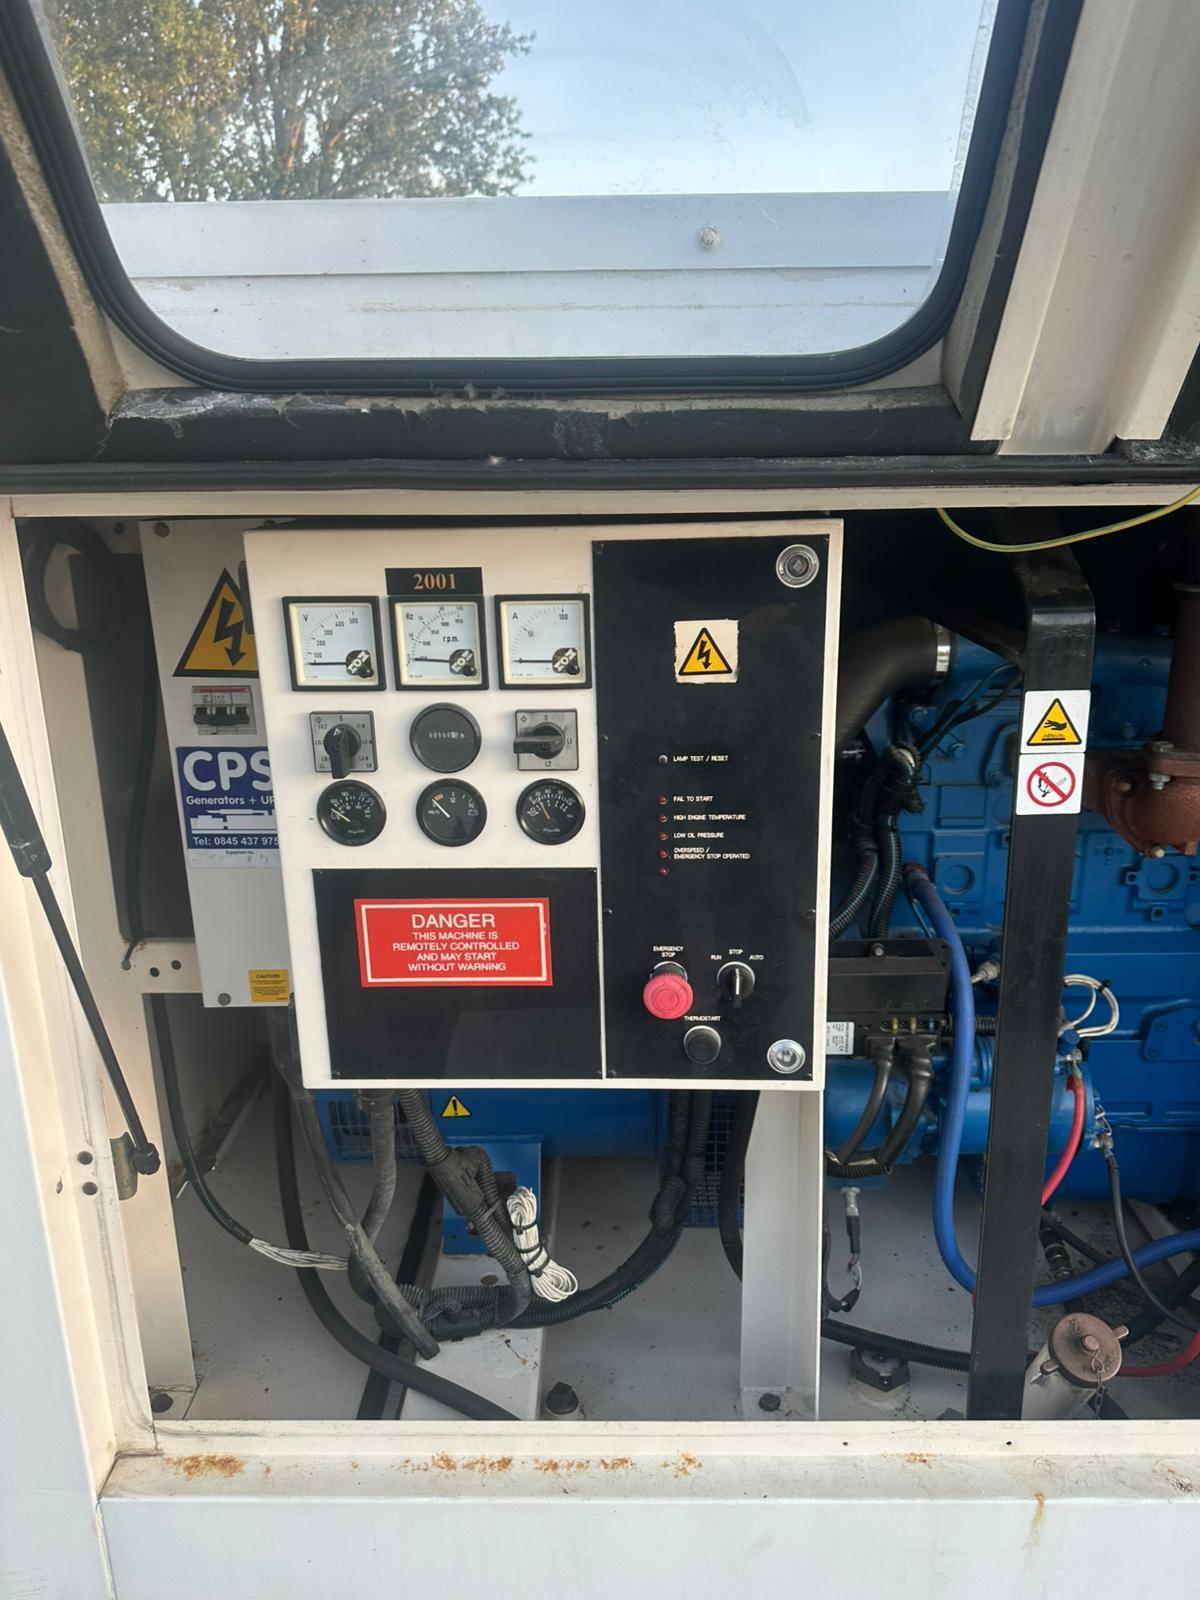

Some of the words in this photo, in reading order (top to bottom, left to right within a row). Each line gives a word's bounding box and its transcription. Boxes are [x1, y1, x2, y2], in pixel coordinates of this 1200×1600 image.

[412, 573, 457, 590] 2001
[302, 614, 309, 622] V
[512, 612, 519, 620] A
[559, 613, 569, 621] 100
[183, 751, 274, 791] CPS
[186, 795, 245, 805] Generators
[193, 836, 211, 846] Tel:
[214, 836, 238, 846] 0845
[240, 836, 259, 846] 437
[411, 914, 496, 928] DANGER
[413, 932, 437, 941] THIS
[438, 932, 485, 940] MACHINE
[488, 931, 499, 940] IS
[393, 942, 448, 952] REMOTELY
[449, 942, 520, 951] CONTROLLED
[416, 952, 439, 961] AND
[440, 952, 462, 961] MAY
[464, 952, 497, 961] START
[408, 963, 455, 972] WITHOUT
[457, 962, 507, 972] WARNING
